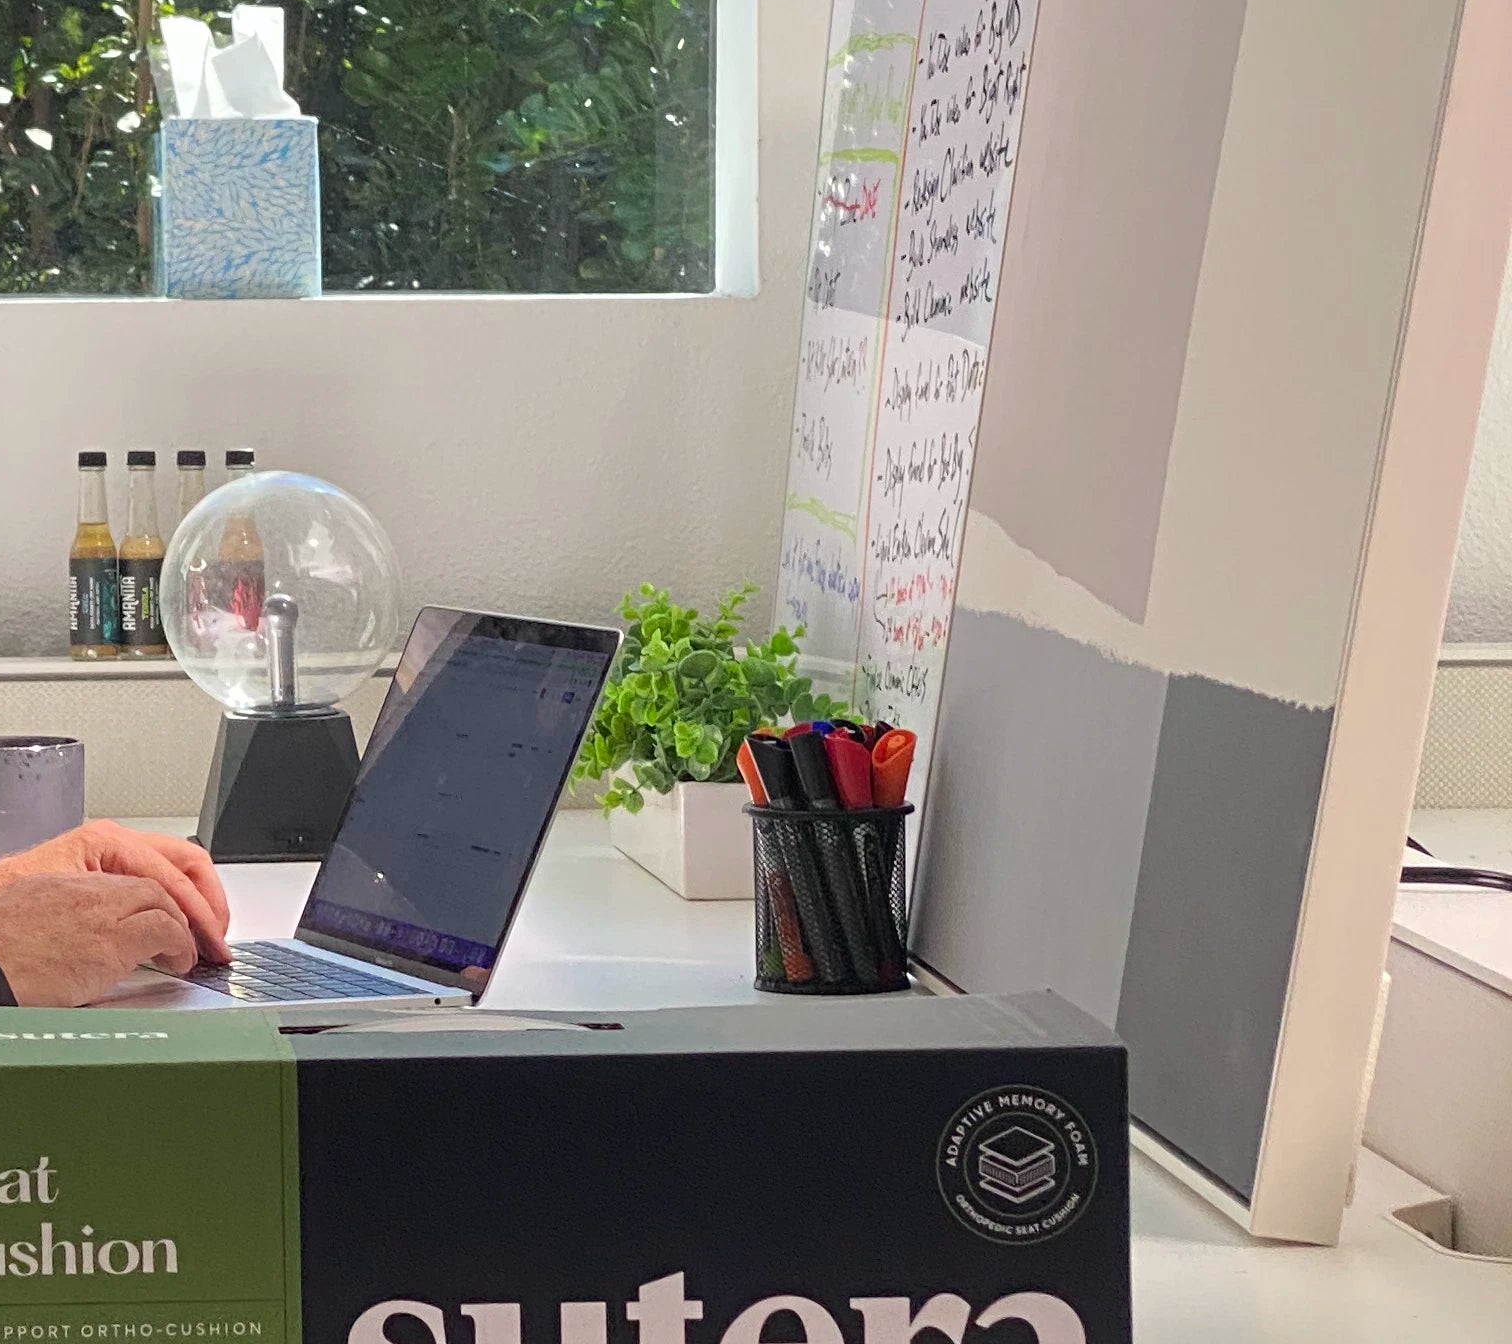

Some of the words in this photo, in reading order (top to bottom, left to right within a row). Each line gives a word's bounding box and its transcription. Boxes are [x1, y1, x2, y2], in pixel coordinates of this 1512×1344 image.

[959, 256, 993, 305] website
[120, 576, 139, 631] AMANITA
[945, 1100, 994, 1168] ADAPTIVE
[997, 1094, 1066, 1120] MEMORY
[1063, 1121, 1089, 1167] FOAM
[955, 1194, 1014, 1235] ORTHOPEDIC
[1015, 1223, 1041, 1236] SEAT
[1041, 1193, 1081, 1229] CUSHION
[80, 1322, 262, 1339] ORTHO-CUSHION
